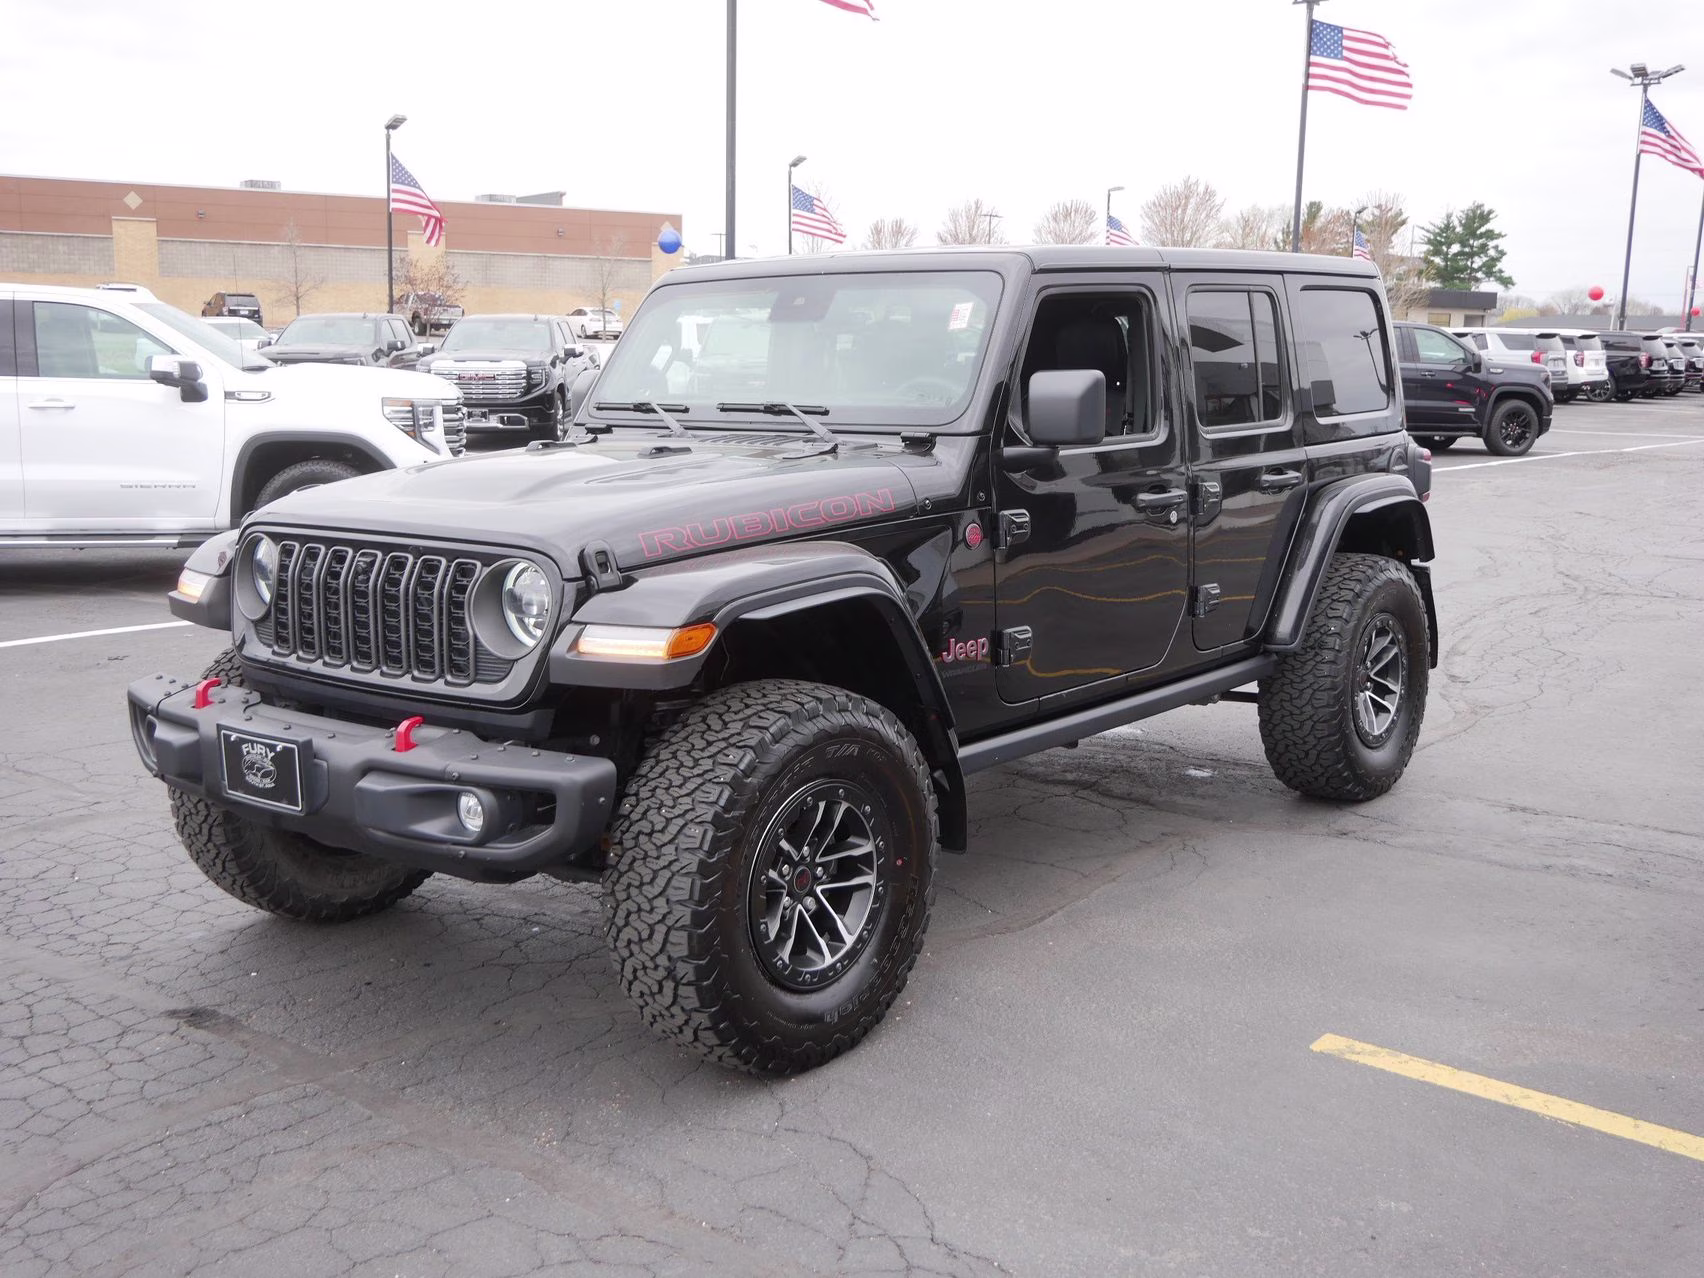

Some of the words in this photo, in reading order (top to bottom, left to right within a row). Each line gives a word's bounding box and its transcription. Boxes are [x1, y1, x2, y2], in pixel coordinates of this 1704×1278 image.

[638, 488, 897, 559] RUBICON
[942, 637, 990, 663] Jeep
[241, 742, 275, 760] FURY
